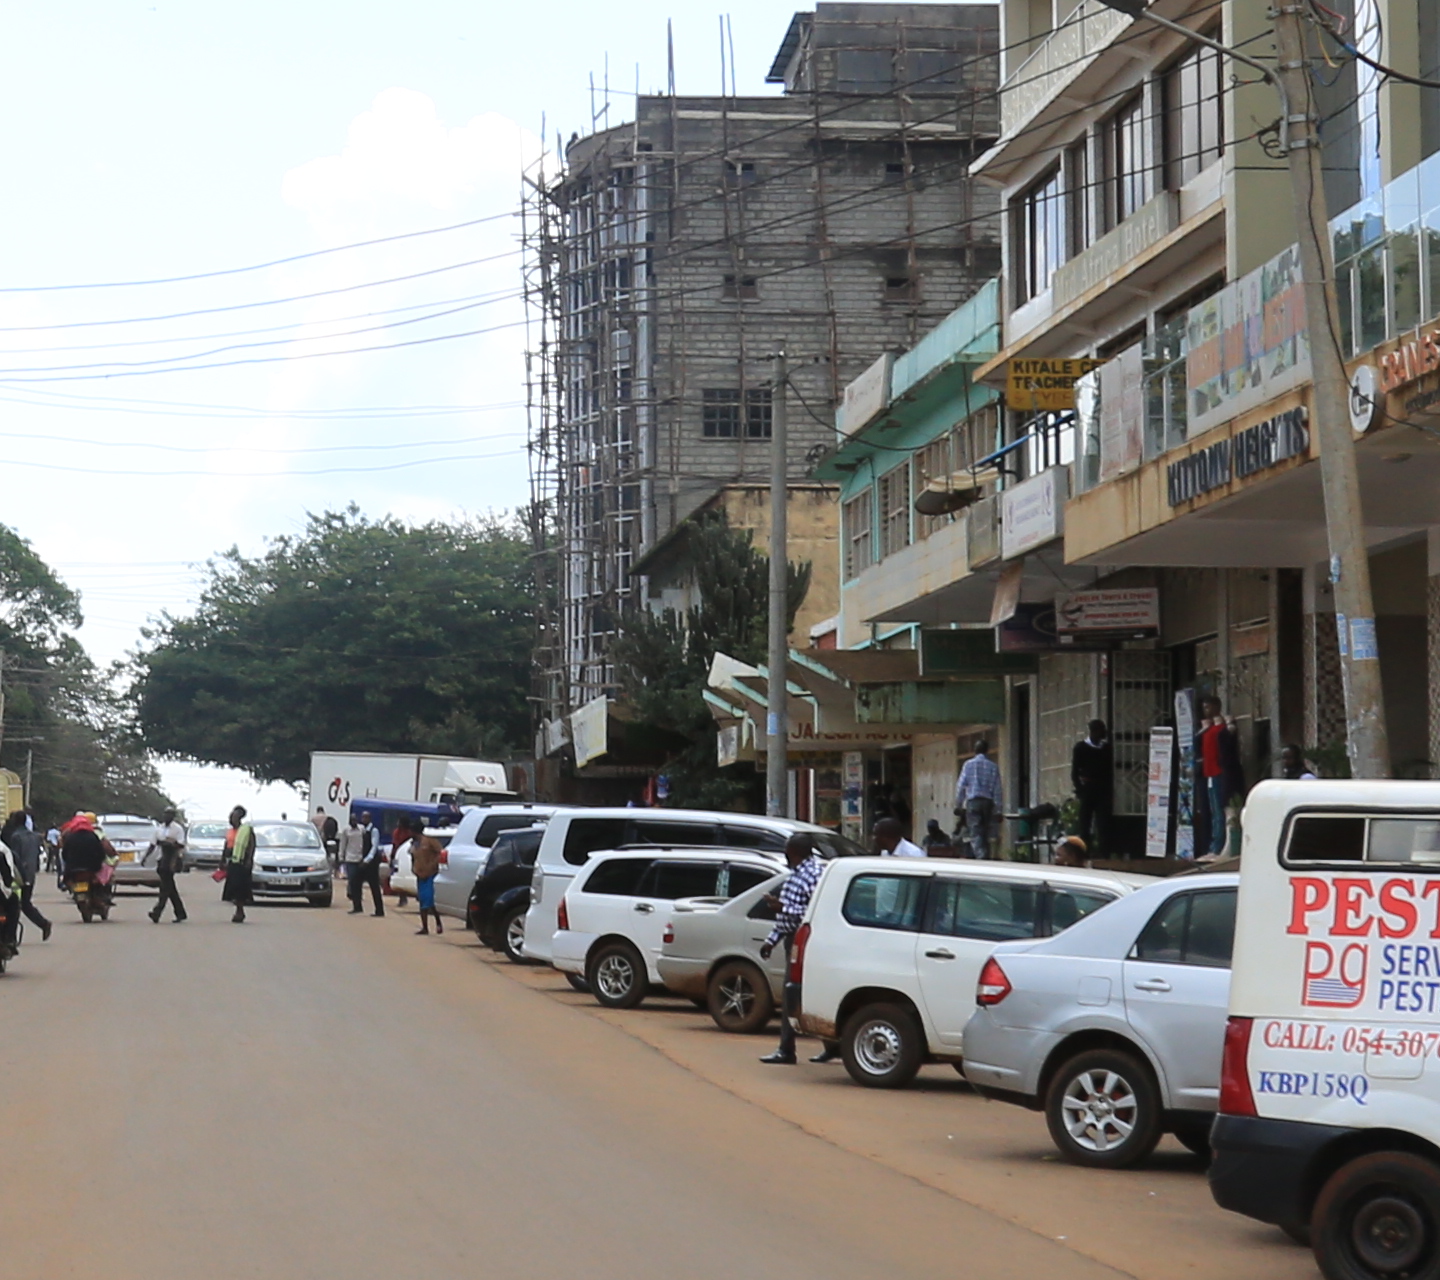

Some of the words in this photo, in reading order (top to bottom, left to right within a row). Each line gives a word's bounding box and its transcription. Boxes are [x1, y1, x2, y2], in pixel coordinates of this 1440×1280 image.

[1013, 360, 1070, 374] KITALE
[1234, 405, 1308, 478] HEIGHTS
[1263, 1021, 1335, 1051] CALL:
